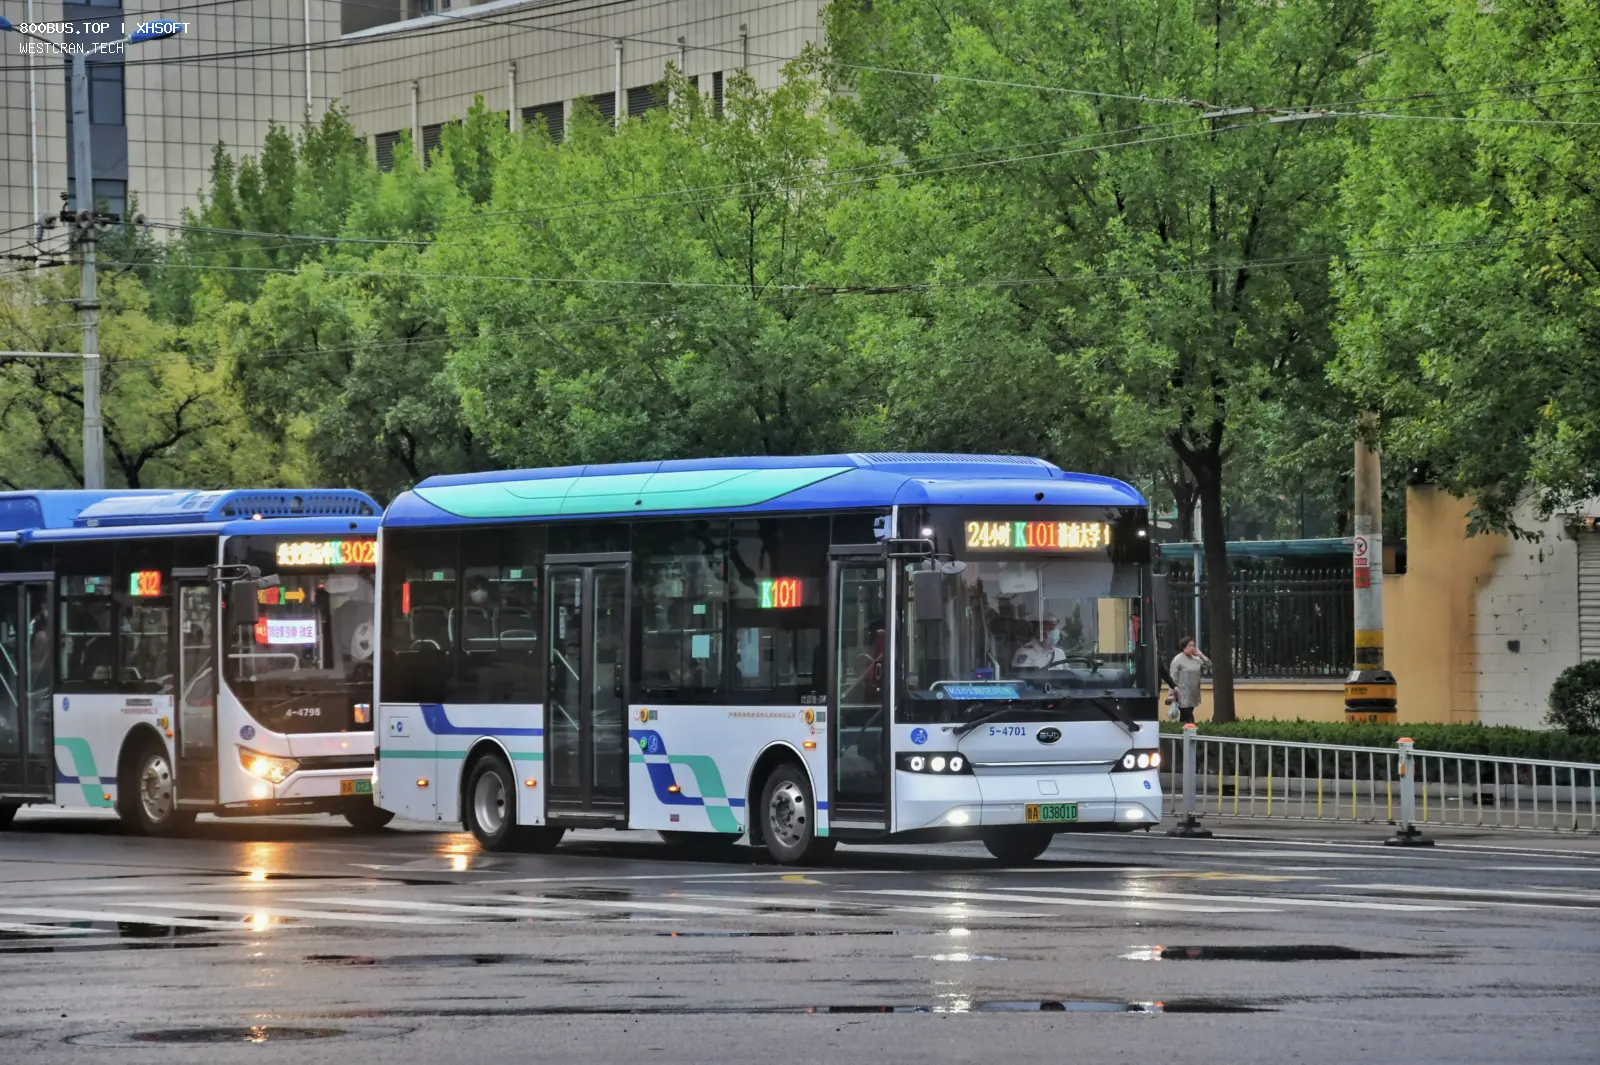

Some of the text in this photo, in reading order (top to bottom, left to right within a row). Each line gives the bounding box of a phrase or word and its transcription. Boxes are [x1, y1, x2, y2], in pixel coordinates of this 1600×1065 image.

[1014, 521, 1058, 548] K101
[761, 579, 798, 608] K101
[285, 707, 321, 717] 4-4798
[989, 726, 1027, 736] 5-4701
[1039, 731, 1060, 740] BYD
